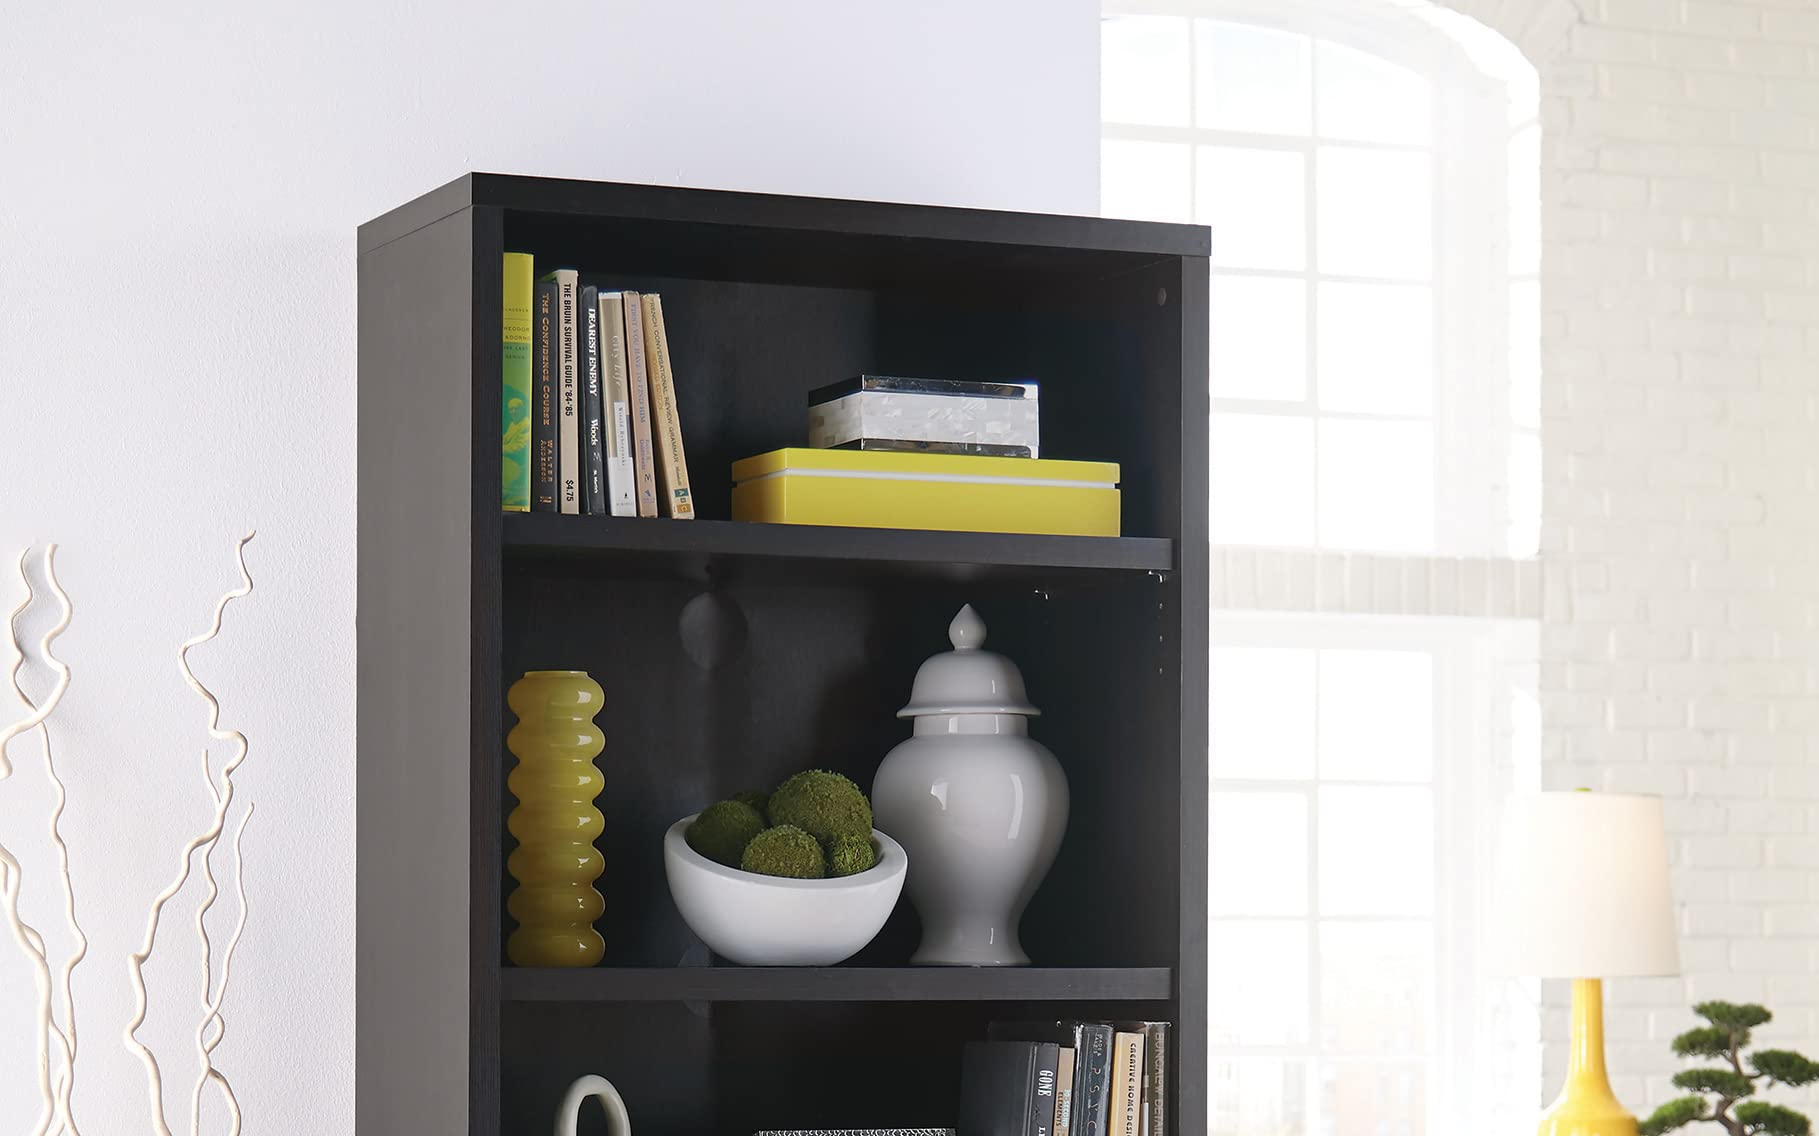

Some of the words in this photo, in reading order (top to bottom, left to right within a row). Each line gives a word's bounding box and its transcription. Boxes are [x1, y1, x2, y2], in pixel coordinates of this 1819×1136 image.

[542, 293, 550, 315] THE
[564, 327, 572, 363] SURVIVAL
[588, 309, 597, 356] DEAREST
[542, 320, 550, 382] CONFIDENCE
[654, 330, 669, 394] CONVERSATIONAL
[589, 357, 598, 397] ENEMY
[543, 385, 551, 425] COURSE
[664, 396, 674, 424] REVIEW
[590, 419, 599, 446] Woods
[668, 427, 679, 462] GRAMMAR
[565, 480, 574, 502] $4.75
[1128, 1043, 1137, 1083] CREATIVE
[1038, 1070, 1053, 1097] GONE
[1056, 1091, 1064, 1127] ELEMENTS
